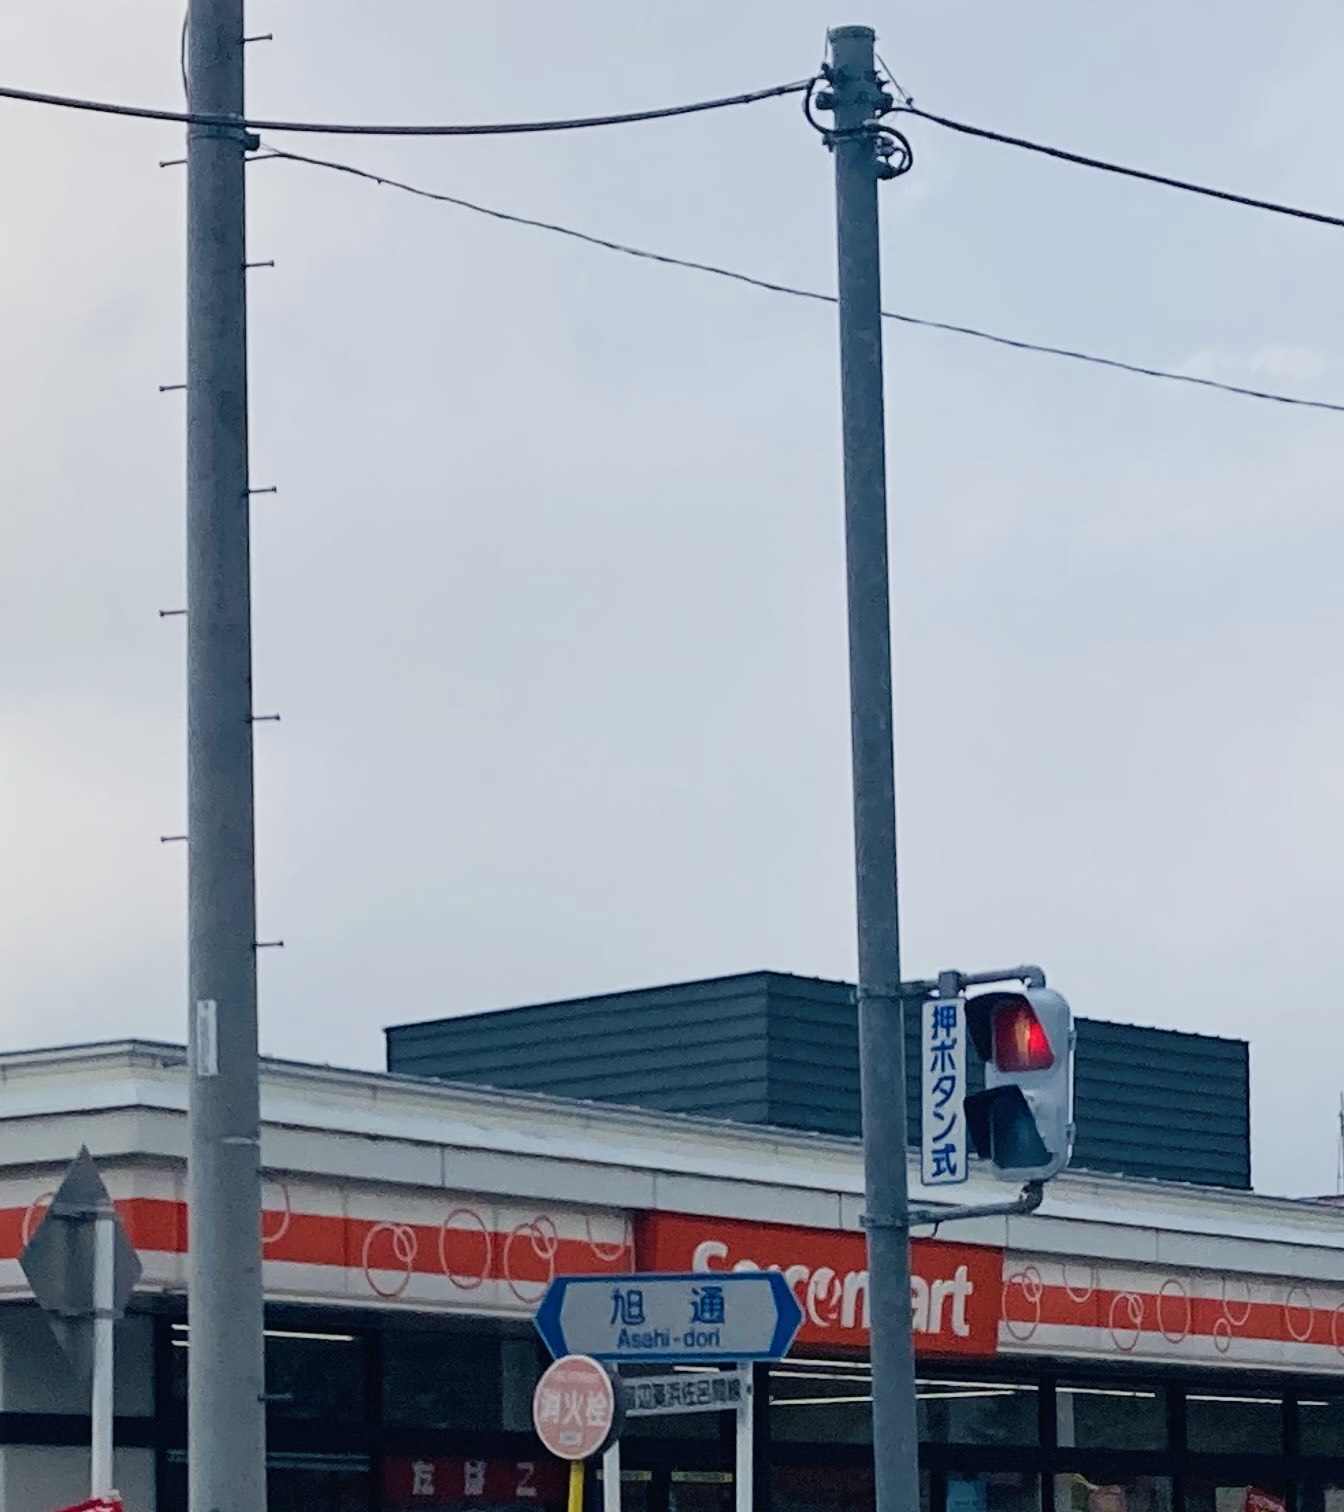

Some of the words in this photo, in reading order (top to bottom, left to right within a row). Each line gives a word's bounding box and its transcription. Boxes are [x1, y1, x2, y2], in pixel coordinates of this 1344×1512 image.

[930, 1005, 957, 1178] 押ボタン式
[692, 1240, 974, 1337] comart
[617, 1327, 720, 1349] Asahi-dori
[538, 1388, 607, 1428] 消火栓
